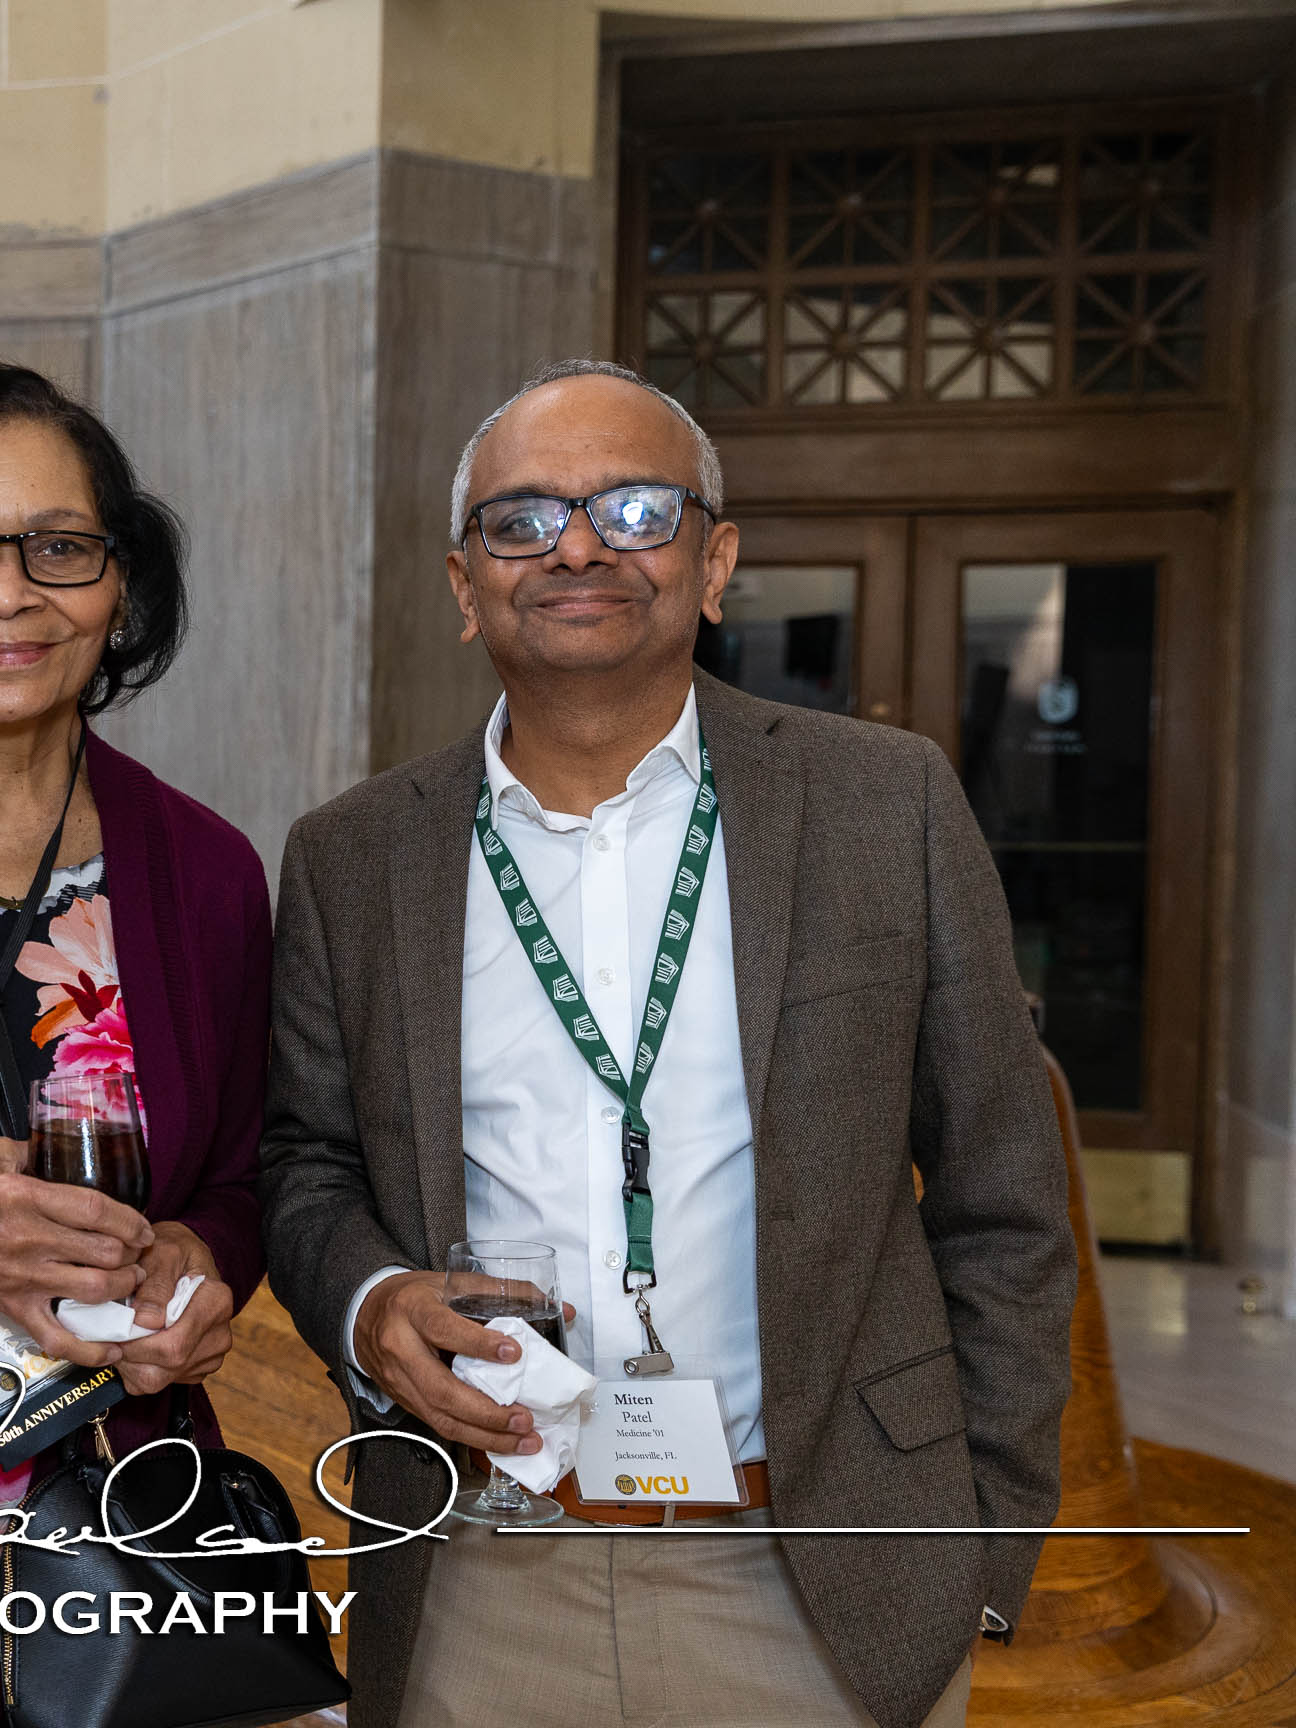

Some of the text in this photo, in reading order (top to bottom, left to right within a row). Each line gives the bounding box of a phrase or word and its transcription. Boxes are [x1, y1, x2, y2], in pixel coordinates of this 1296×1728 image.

[24, 1366, 117, 1433] ANNIVERSARY
[613, 1393, 654, 1405] Miten
[621, 1411, 653, 1423] Patel
[615, 1429, 652, 1437] Medicine
[615, 1451, 678, 1462] Jacksonville, FL
[634, 1476, 690, 1495] VCU
